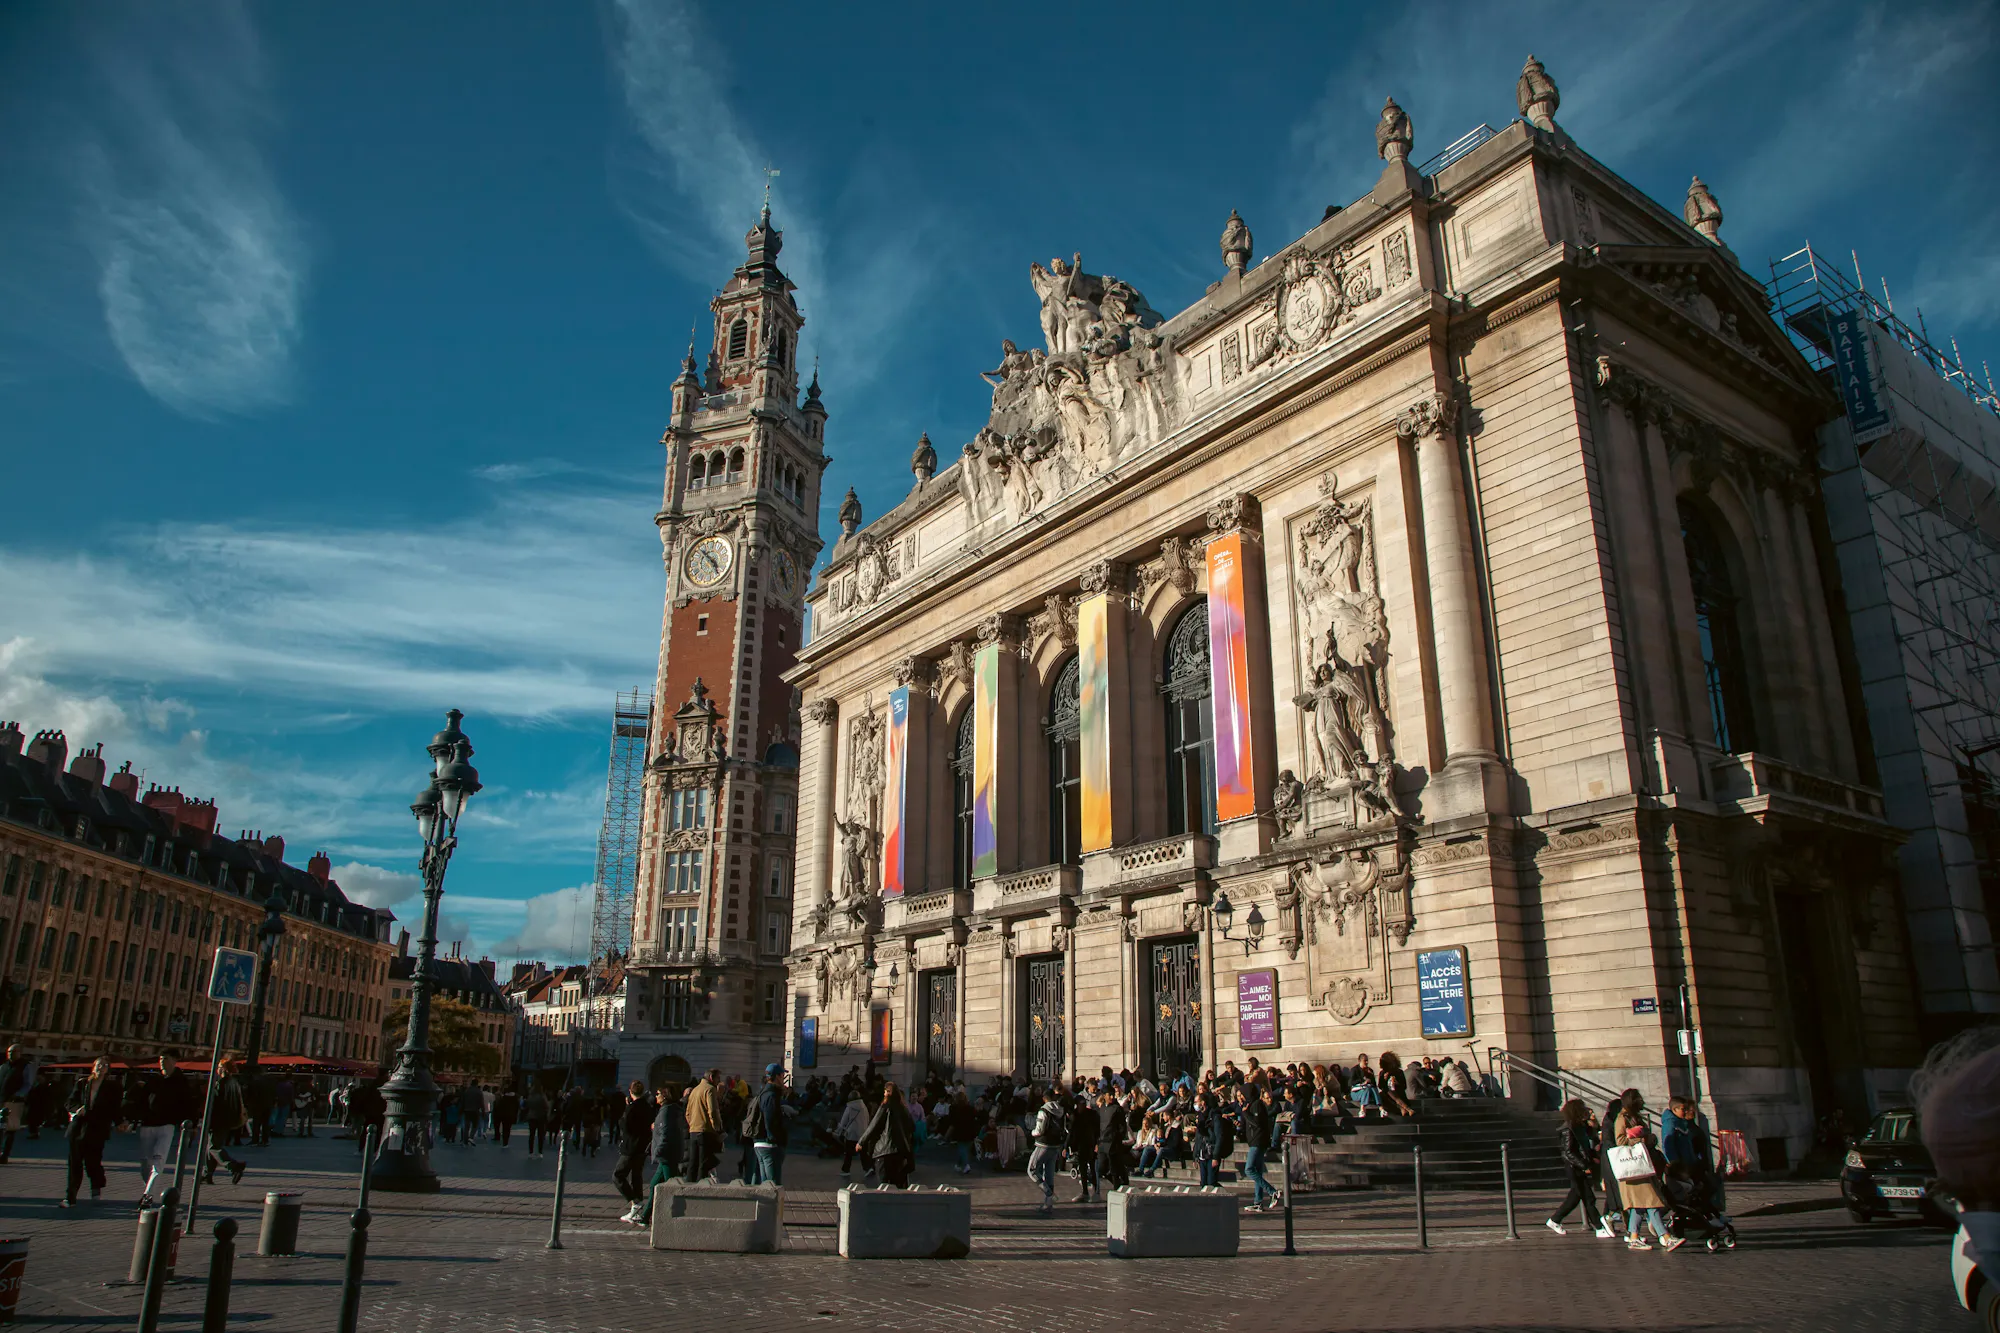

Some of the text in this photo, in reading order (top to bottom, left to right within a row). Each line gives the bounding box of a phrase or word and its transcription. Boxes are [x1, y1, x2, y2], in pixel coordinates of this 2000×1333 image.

[1837, 321, 1866, 414] BATTAIS
[1430, 965, 1462, 978] ACCÈS
[1249, 985, 1272, 995] AIMEZ-
[1421, 979, 1449, 990] BILLET
[1258, 994, 1272, 1002] MOI
[1439, 988, 1464, 999] TERIE
[1240, 1004, 1253, 1012] PAR
